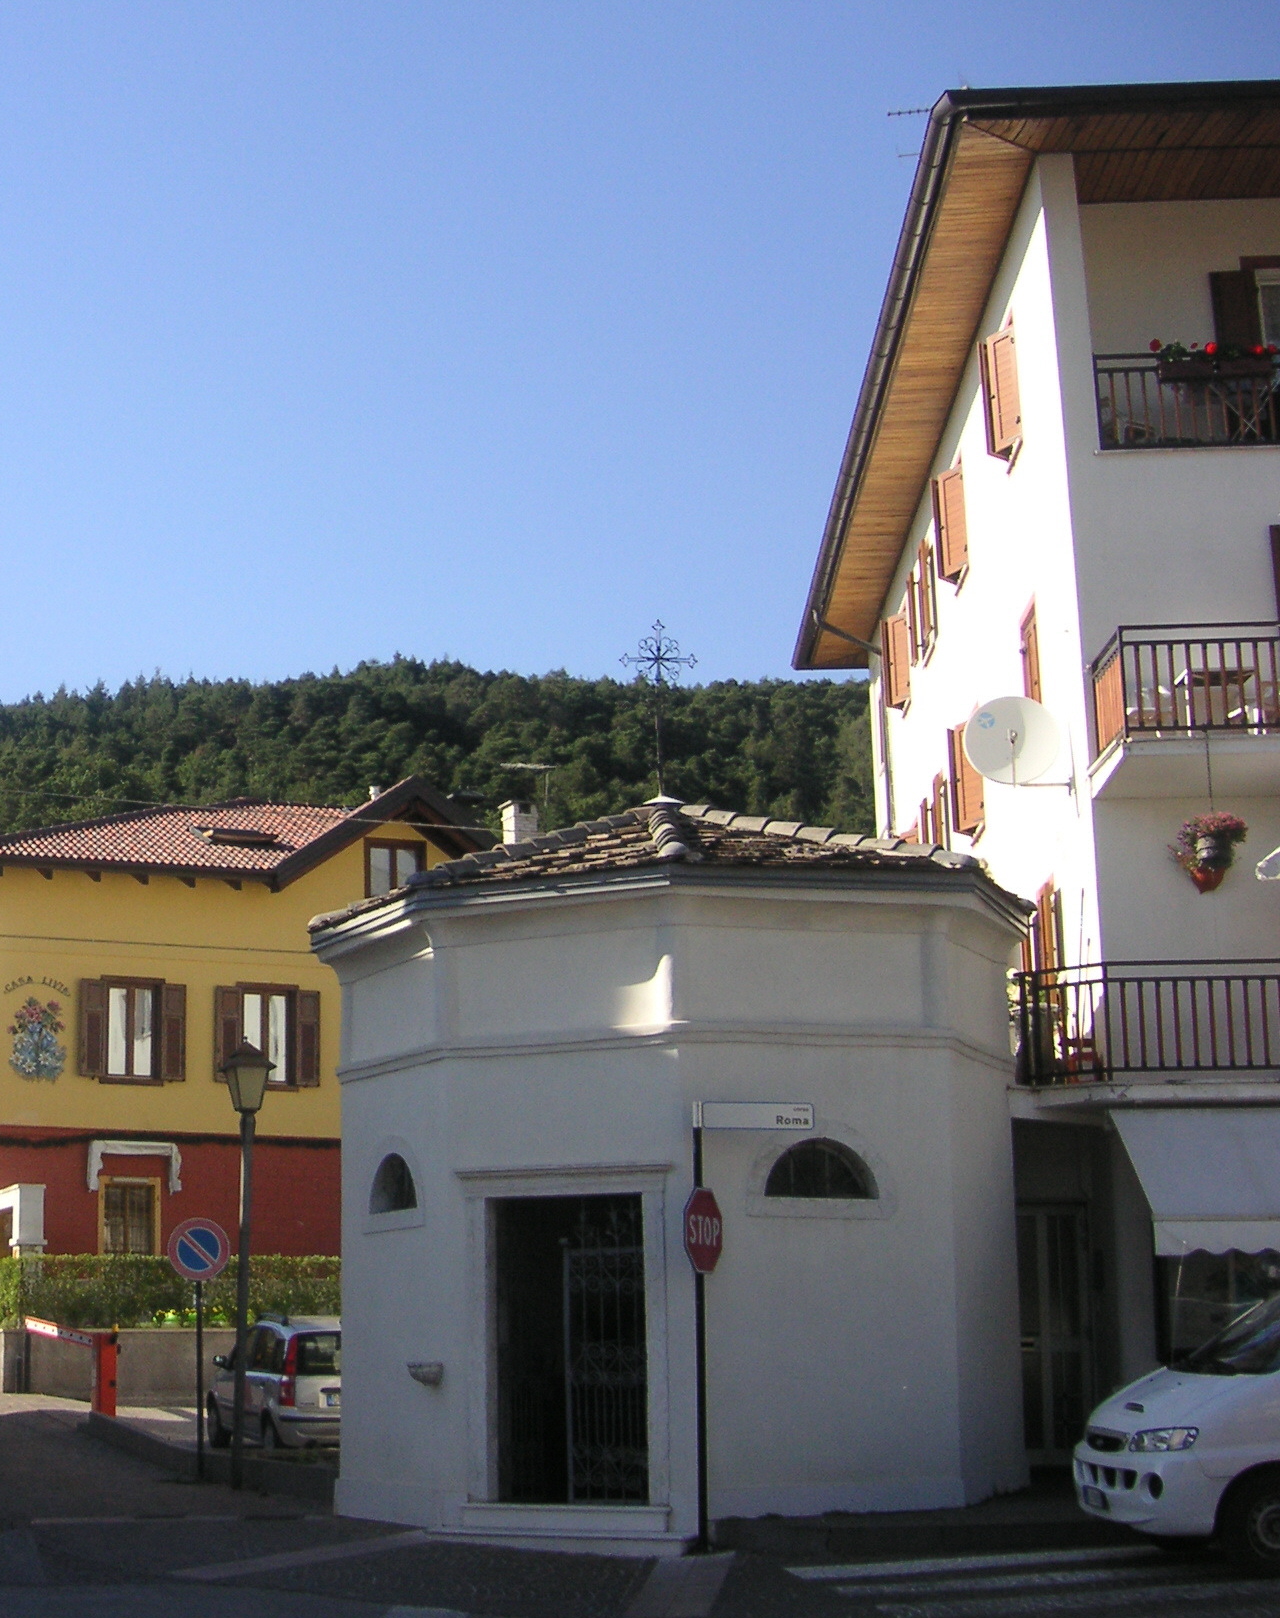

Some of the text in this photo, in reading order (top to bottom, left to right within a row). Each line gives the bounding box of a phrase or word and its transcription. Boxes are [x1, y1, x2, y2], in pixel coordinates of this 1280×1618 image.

[4, 975, 33, 992] CASA
[776, 1115, 809, 1125] Roma
[689, 1215, 720, 1246] STOP
